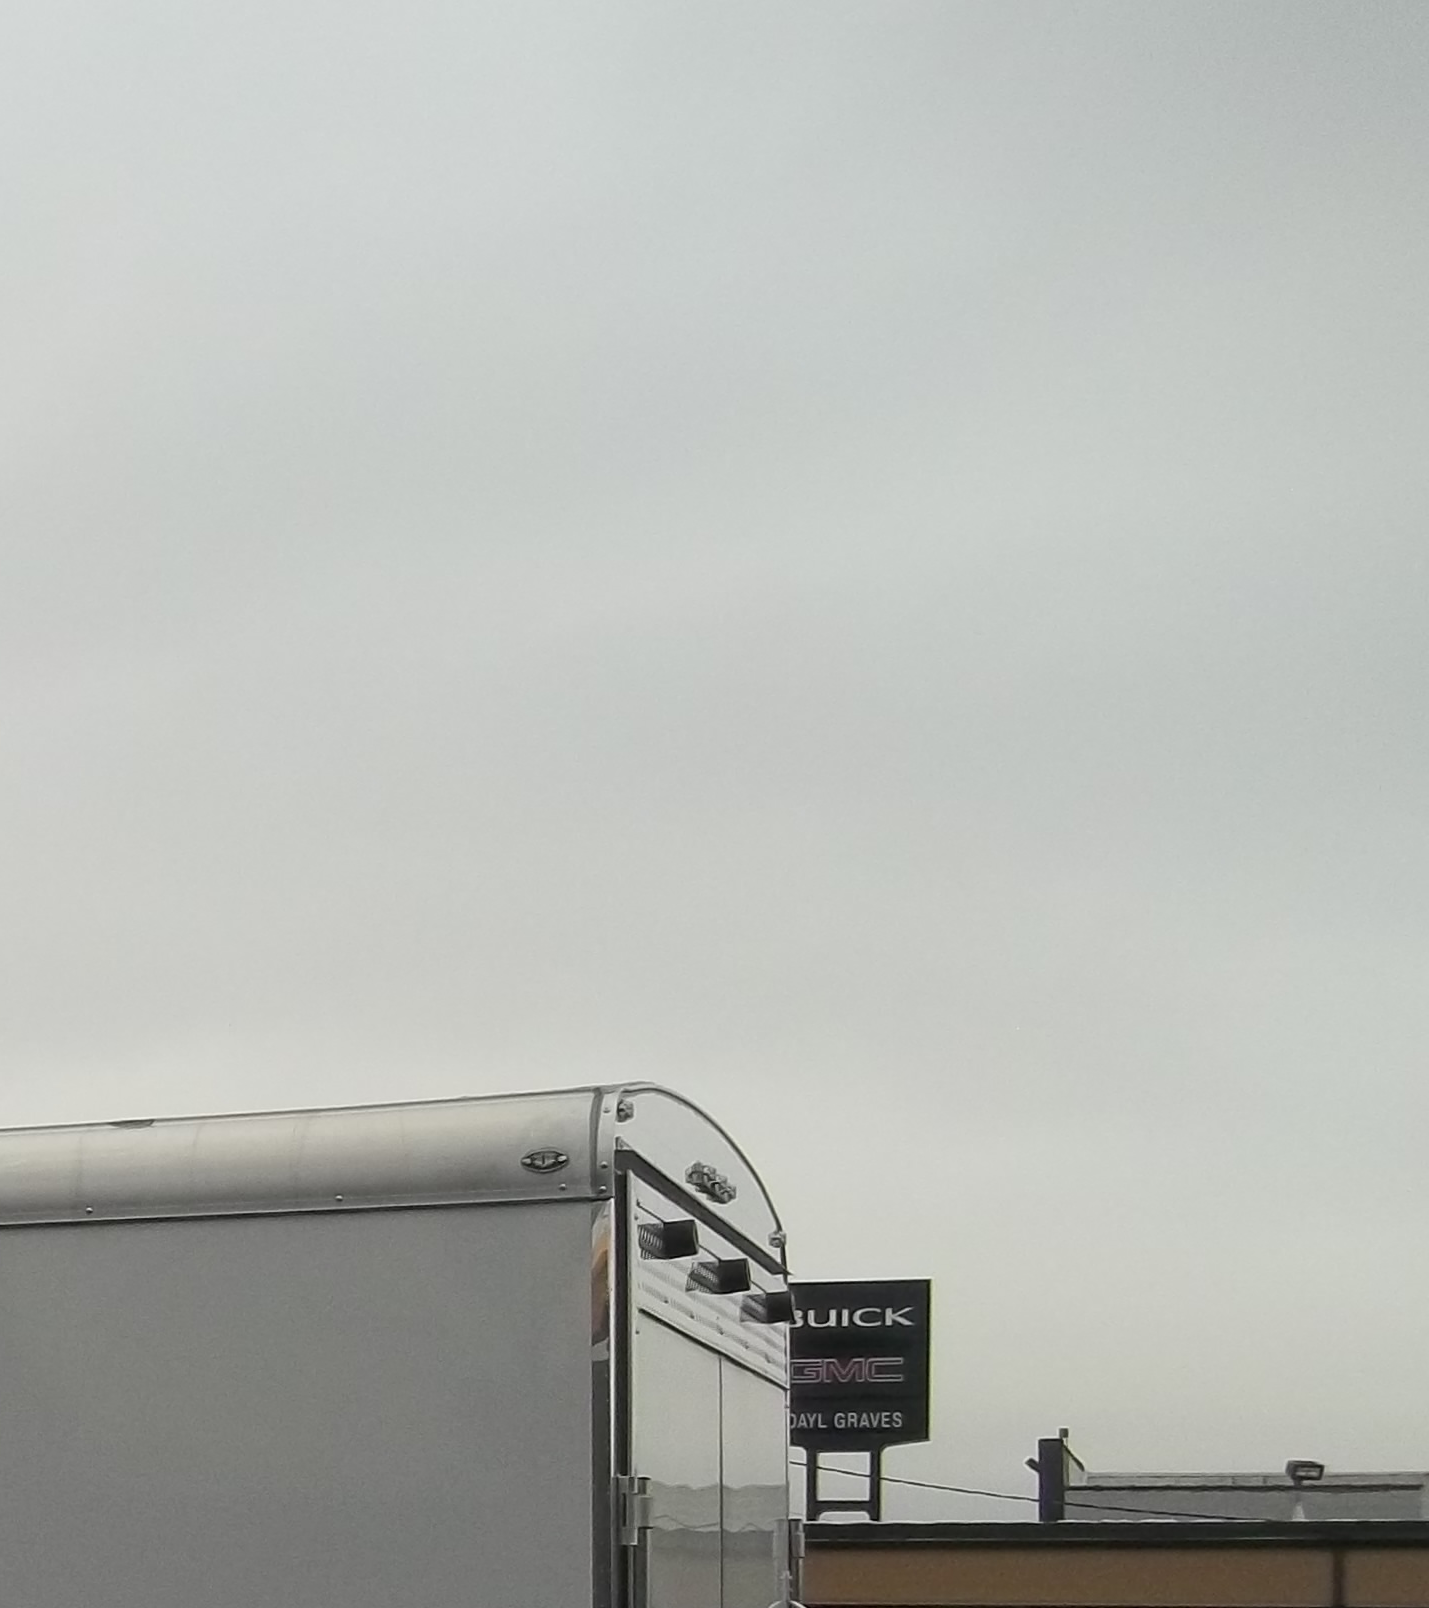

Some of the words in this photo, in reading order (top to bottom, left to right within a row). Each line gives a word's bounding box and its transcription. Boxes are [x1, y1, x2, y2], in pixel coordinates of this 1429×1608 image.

[791, 1306, 915, 1328] BUICK
[791, 1357, 904, 1384] GMC
[834, 1412, 903, 1428] GRAVES
